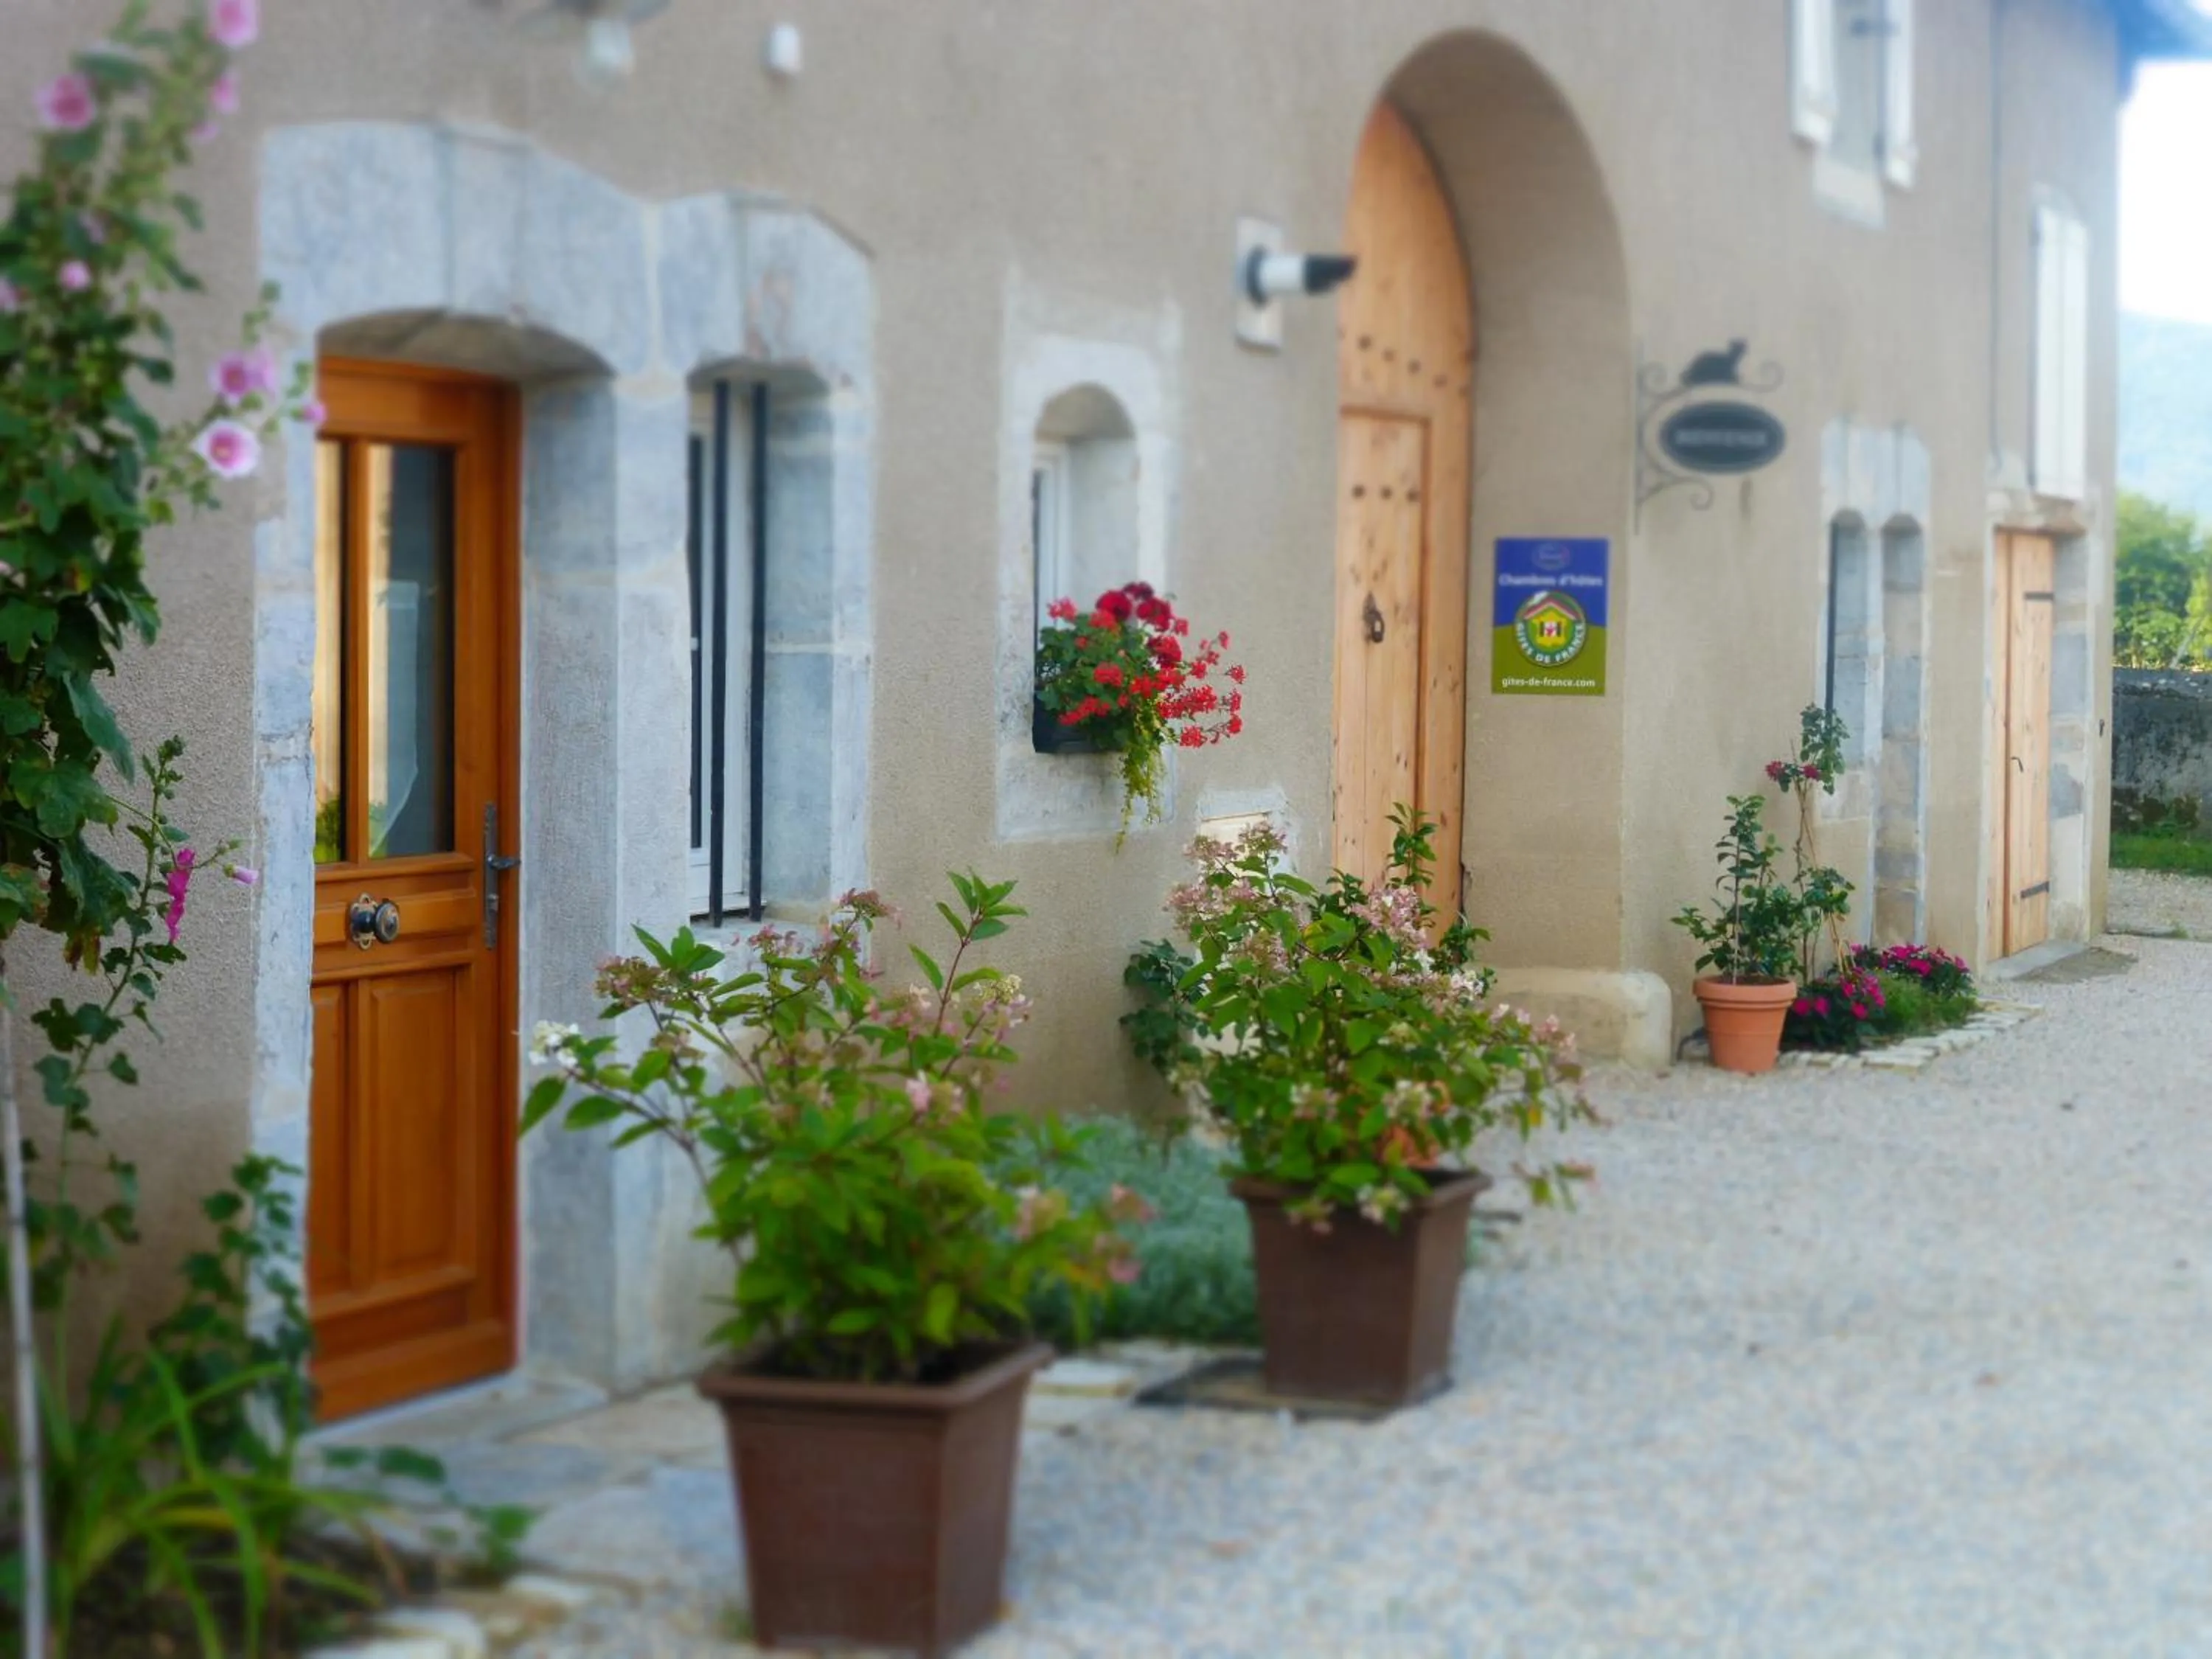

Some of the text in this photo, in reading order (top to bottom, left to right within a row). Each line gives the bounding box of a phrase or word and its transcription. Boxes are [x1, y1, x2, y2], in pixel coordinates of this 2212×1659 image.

[1535, 653, 1551, 663] DE
[1555, 625, 1584, 662] FRANCE
[1502, 676, 1595, 687] gites-de-france.com
